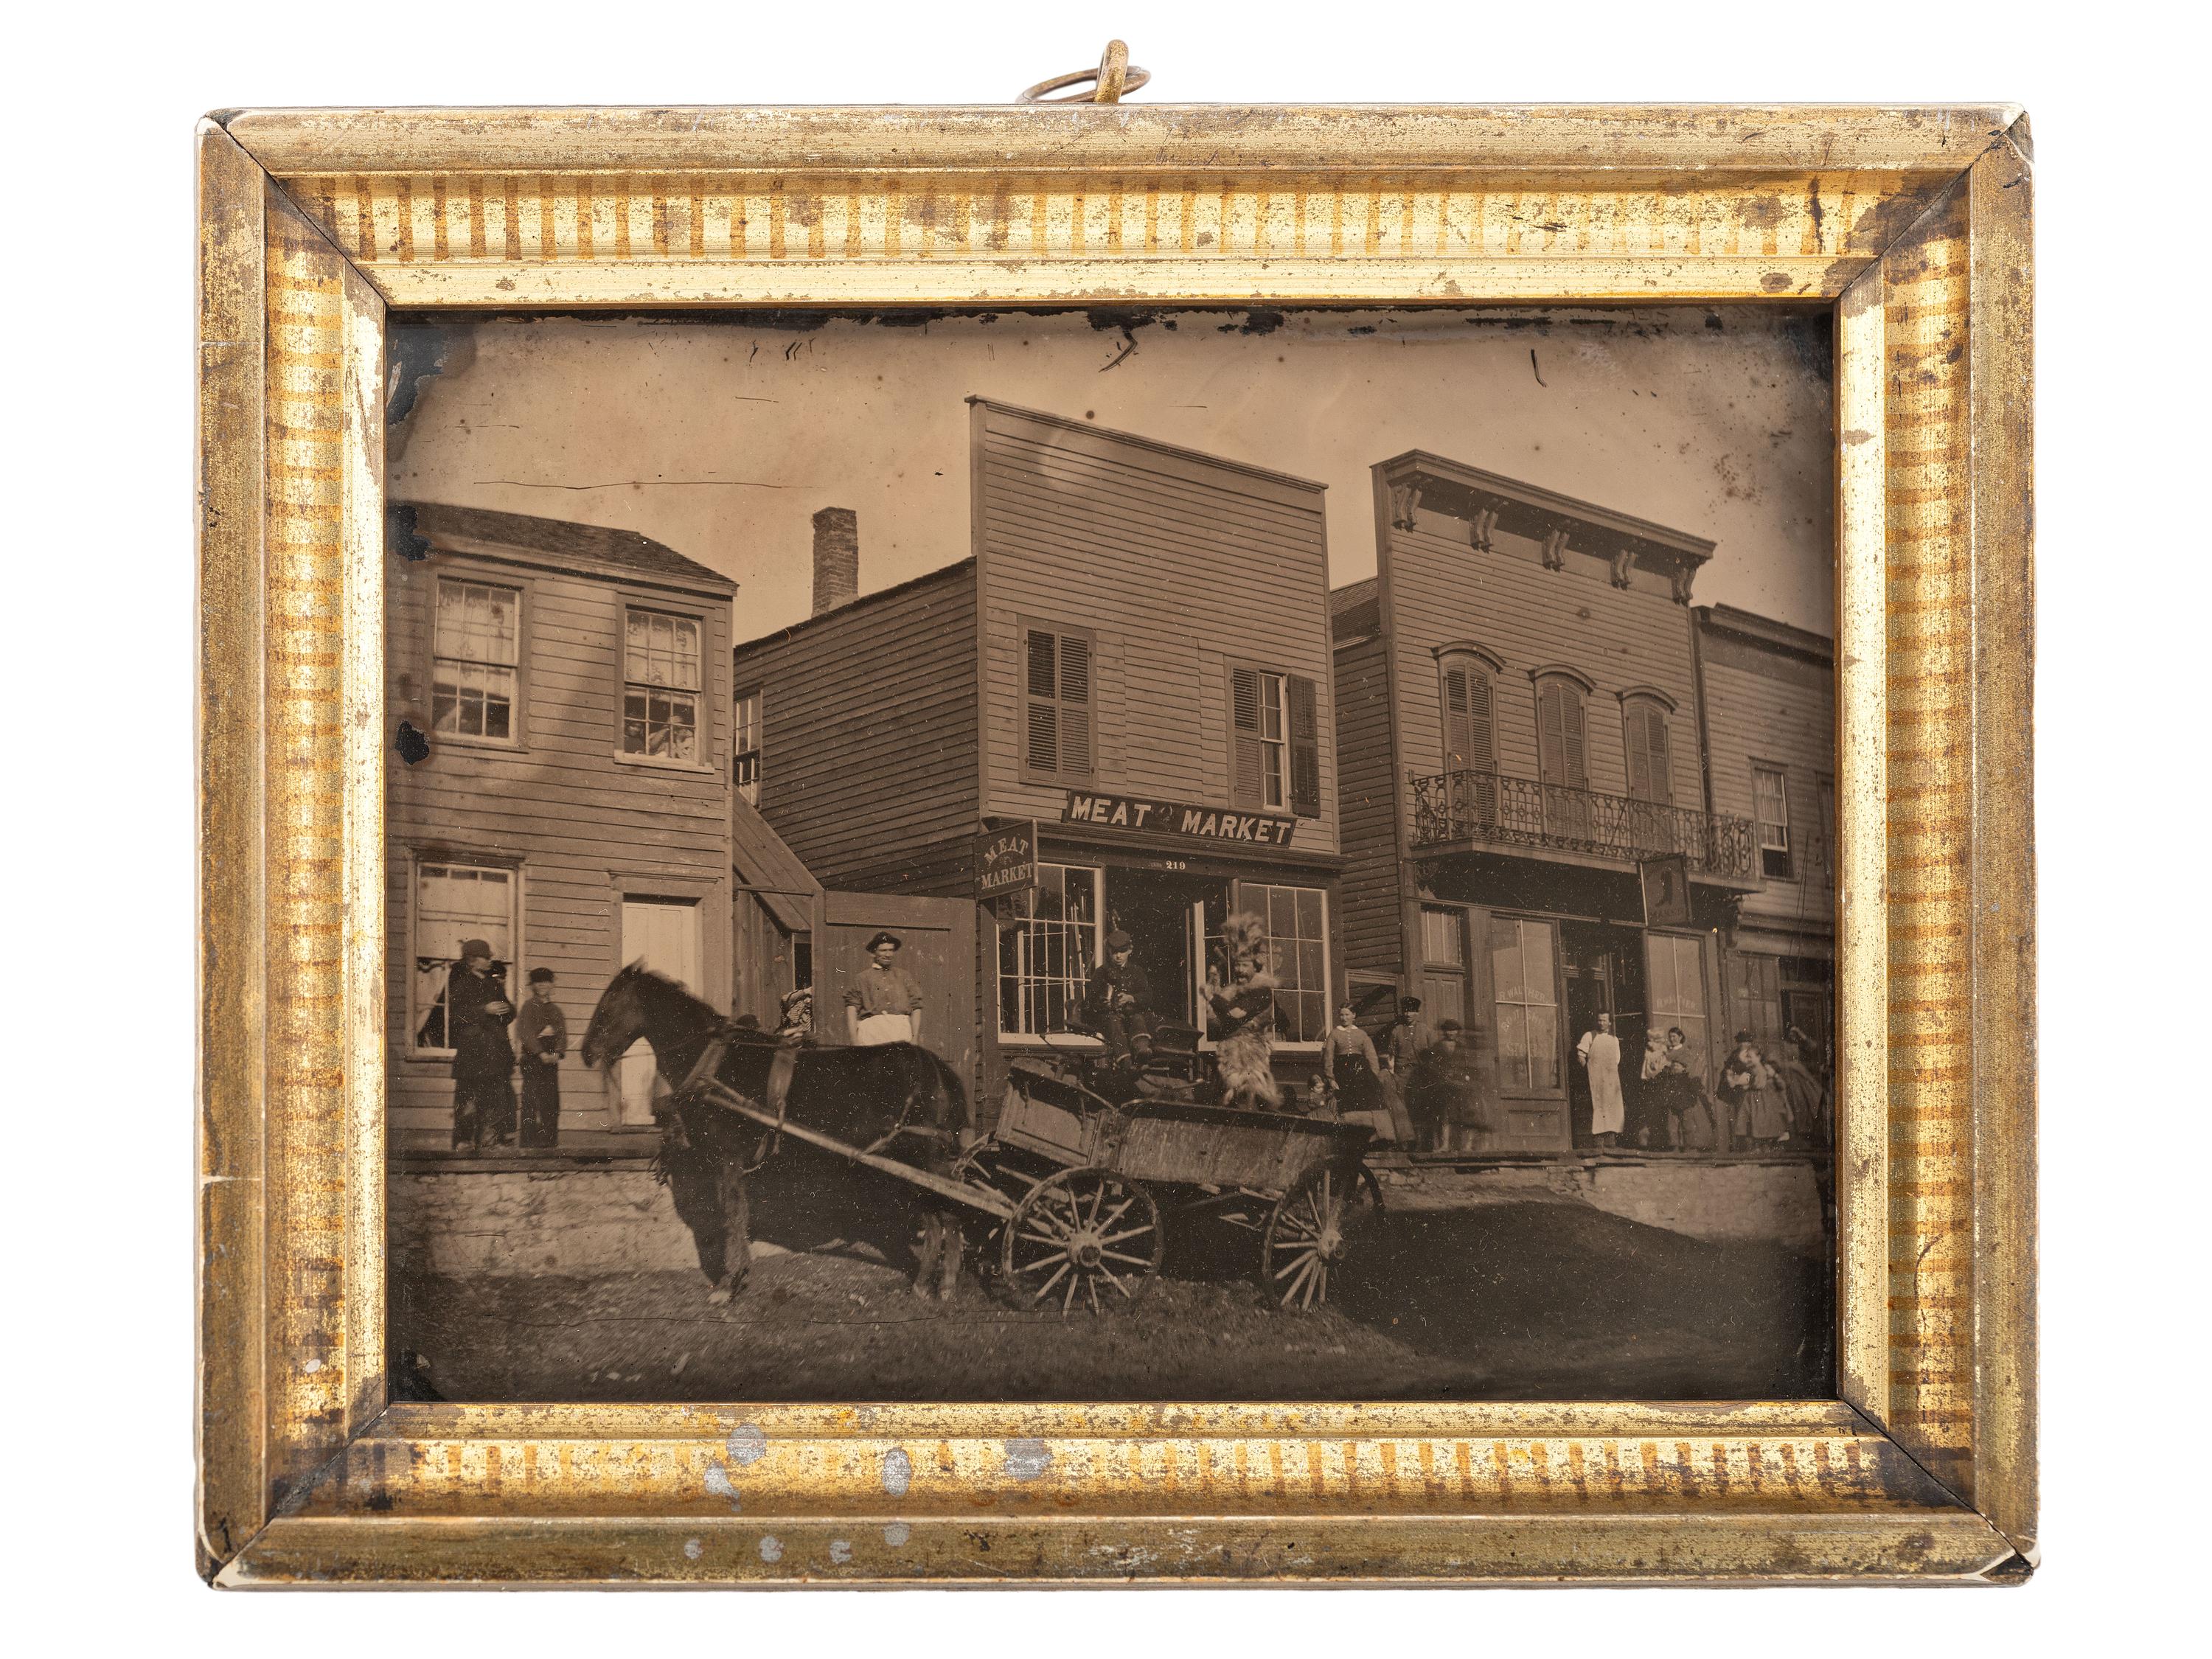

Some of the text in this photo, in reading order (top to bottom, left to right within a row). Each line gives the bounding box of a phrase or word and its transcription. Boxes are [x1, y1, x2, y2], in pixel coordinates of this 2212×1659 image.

[1071, 796, 1291, 844] MEAT MARKET
[984, 836, 1029, 868] MEAT
[1166, 860, 1186, 870] 219
[981, 862, 1033, 890] MARKET
